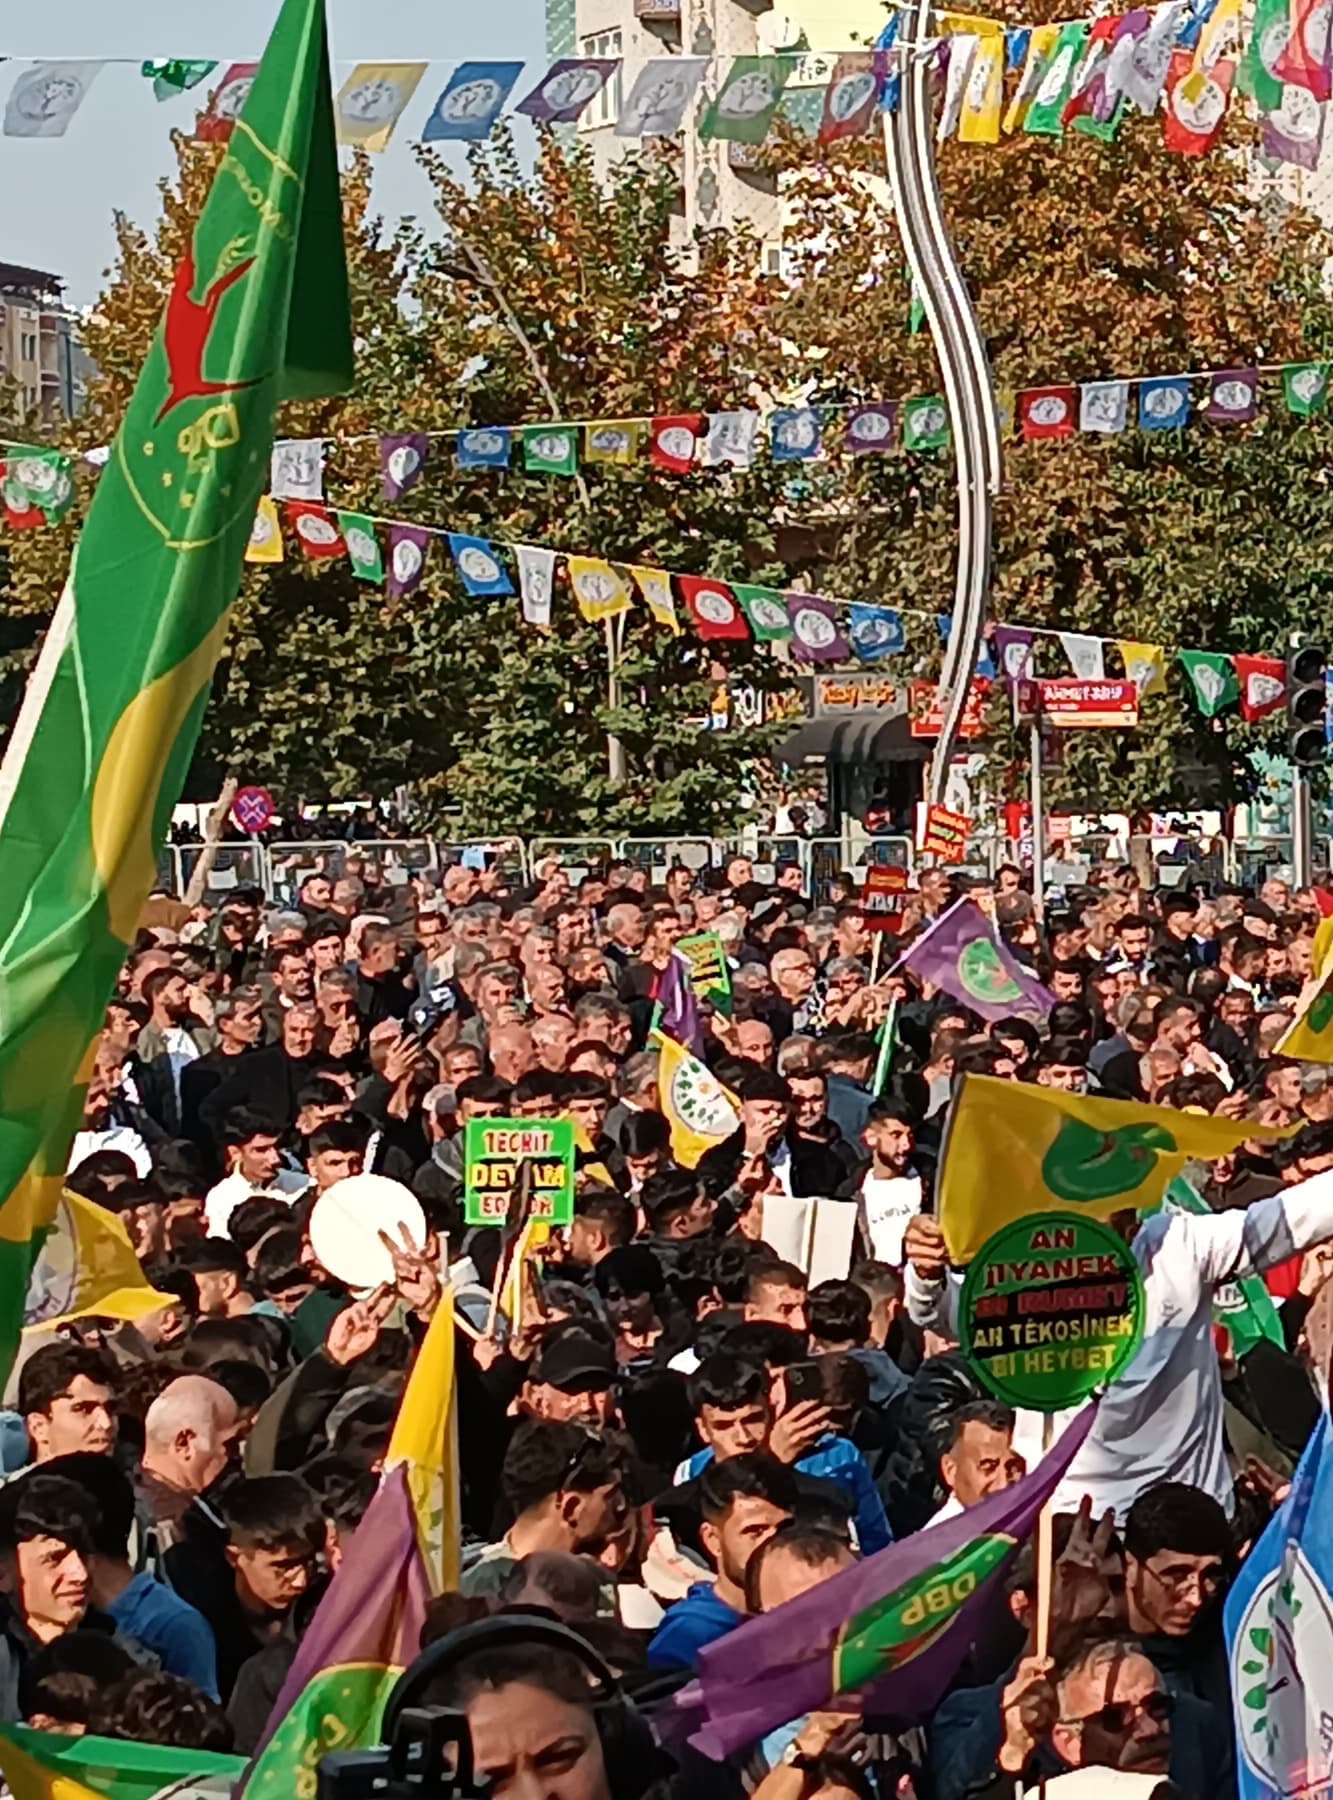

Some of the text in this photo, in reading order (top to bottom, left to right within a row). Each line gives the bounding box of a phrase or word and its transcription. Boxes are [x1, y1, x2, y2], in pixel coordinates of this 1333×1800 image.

[1030, 1228, 1076, 1249] AN
[973, 1326, 1003, 1348] AN
[1023, 1344, 1118, 1374] HEYBET
